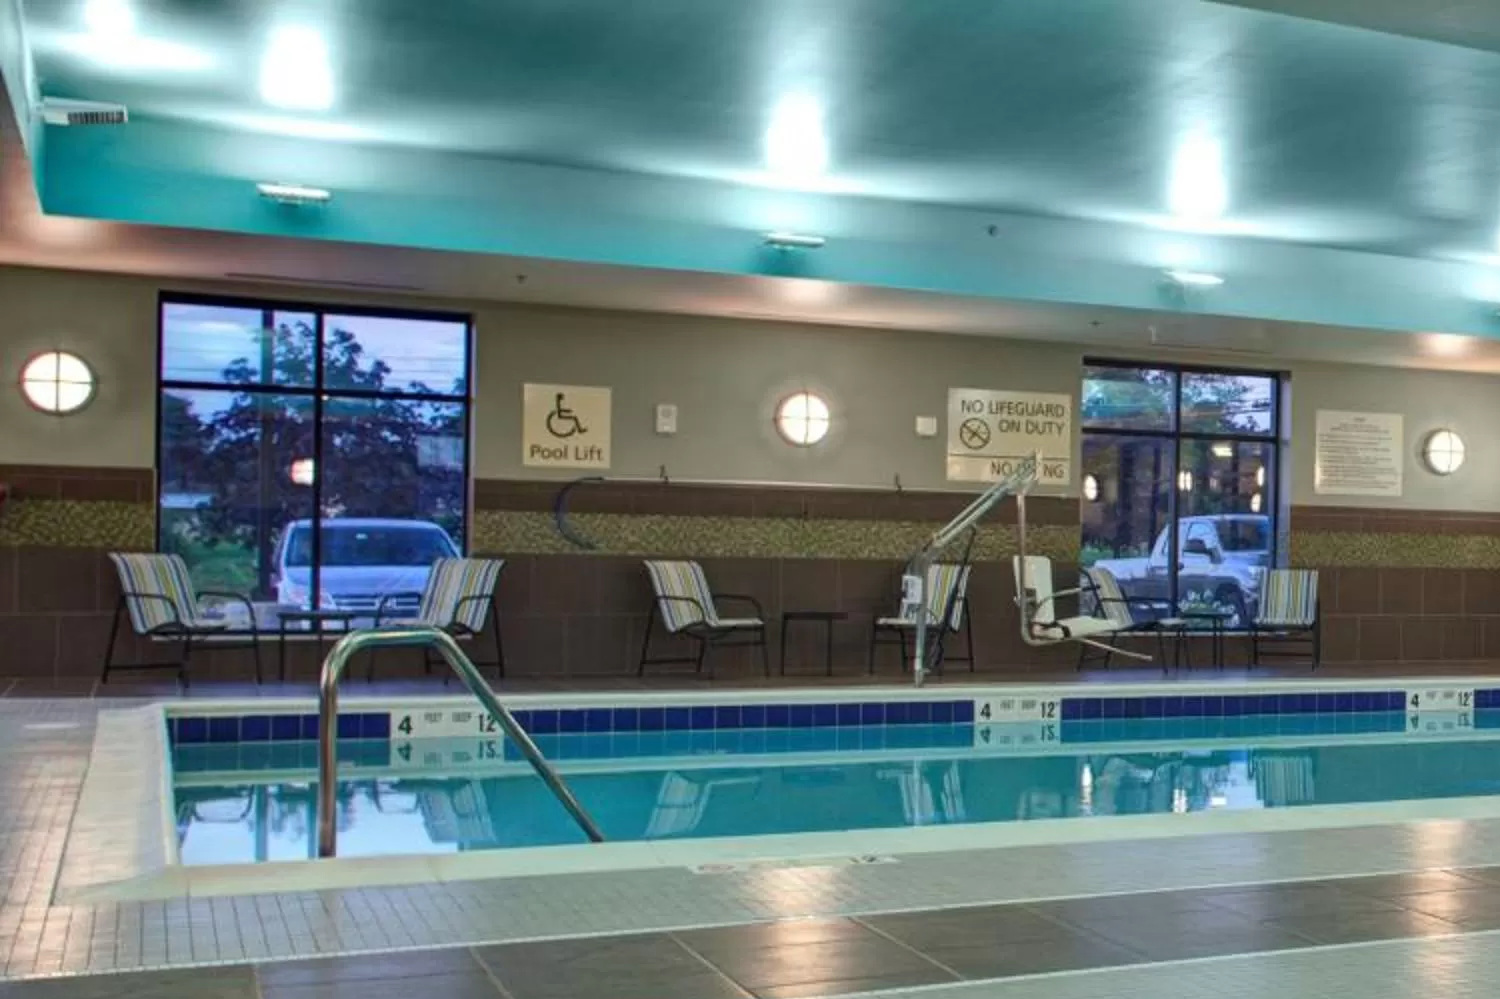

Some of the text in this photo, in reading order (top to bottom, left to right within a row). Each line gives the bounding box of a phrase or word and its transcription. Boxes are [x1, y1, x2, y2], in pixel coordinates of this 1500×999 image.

[961, 399, 1065, 418] NO LIFEGUARD
[998, 419, 1065, 437] ON DUTY
[530, 444, 604, 461] Pool Lift
[991, 461, 1012, 476] NO
[1410, 693, 1419, 708] 4
[980, 702, 992, 720] 4
[398, 715, 412, 735] 4
